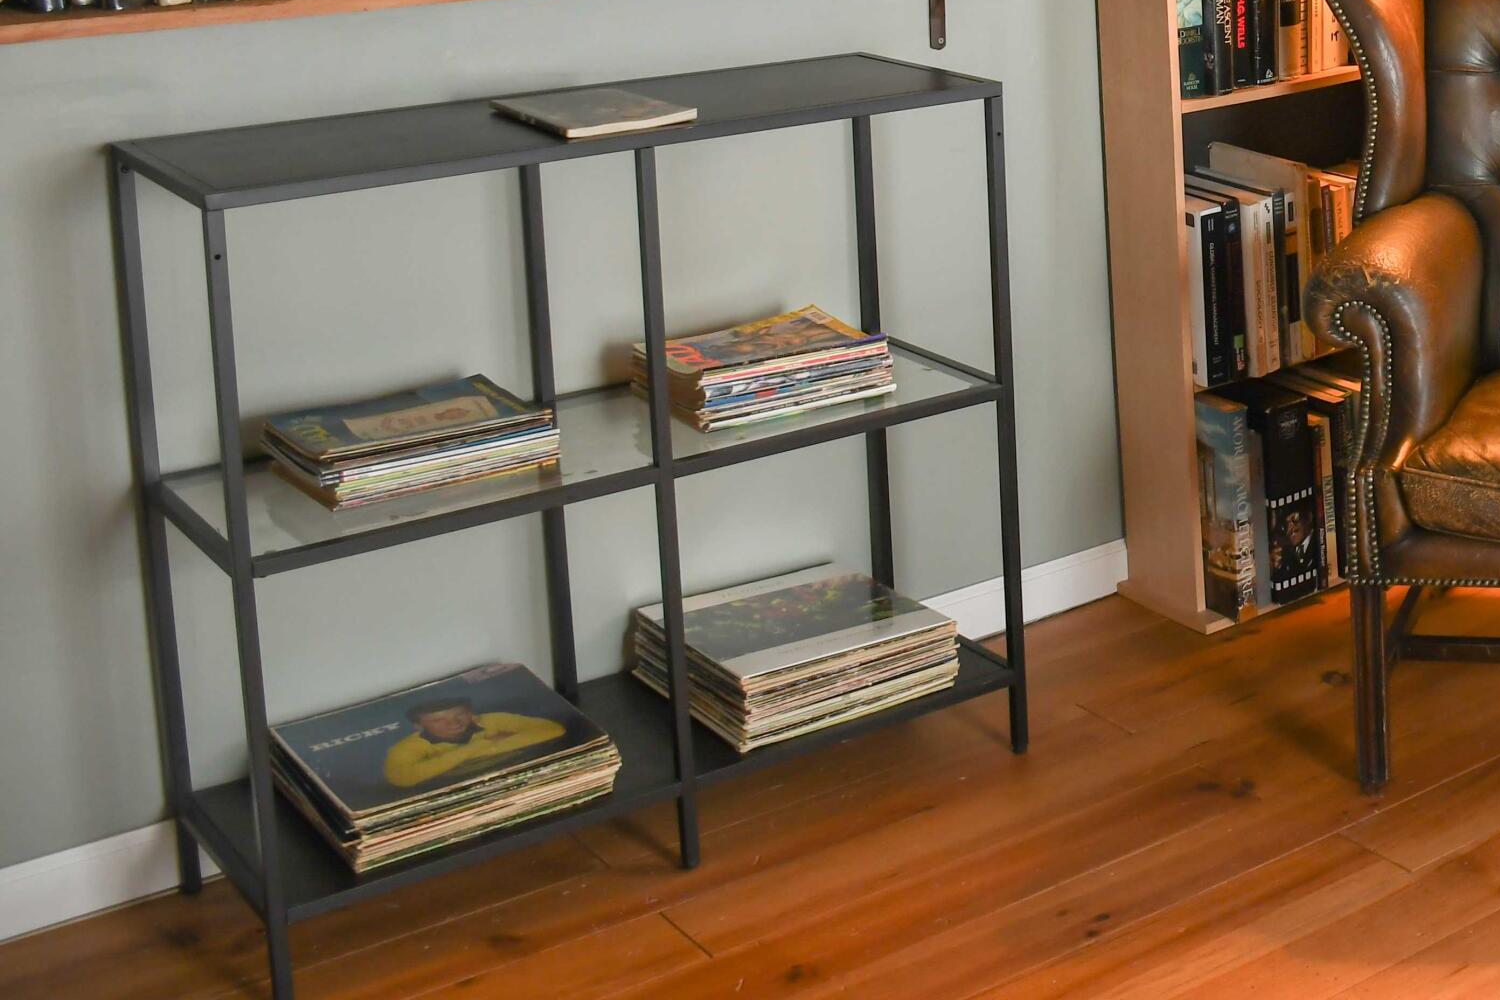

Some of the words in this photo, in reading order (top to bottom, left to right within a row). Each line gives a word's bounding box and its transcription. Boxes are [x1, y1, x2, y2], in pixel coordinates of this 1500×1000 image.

[1216, 0, 1224, 24] MAN
[1223, 6, 1232, 45] ASCENT
[1237, 18, 1245, 49] WELLS
